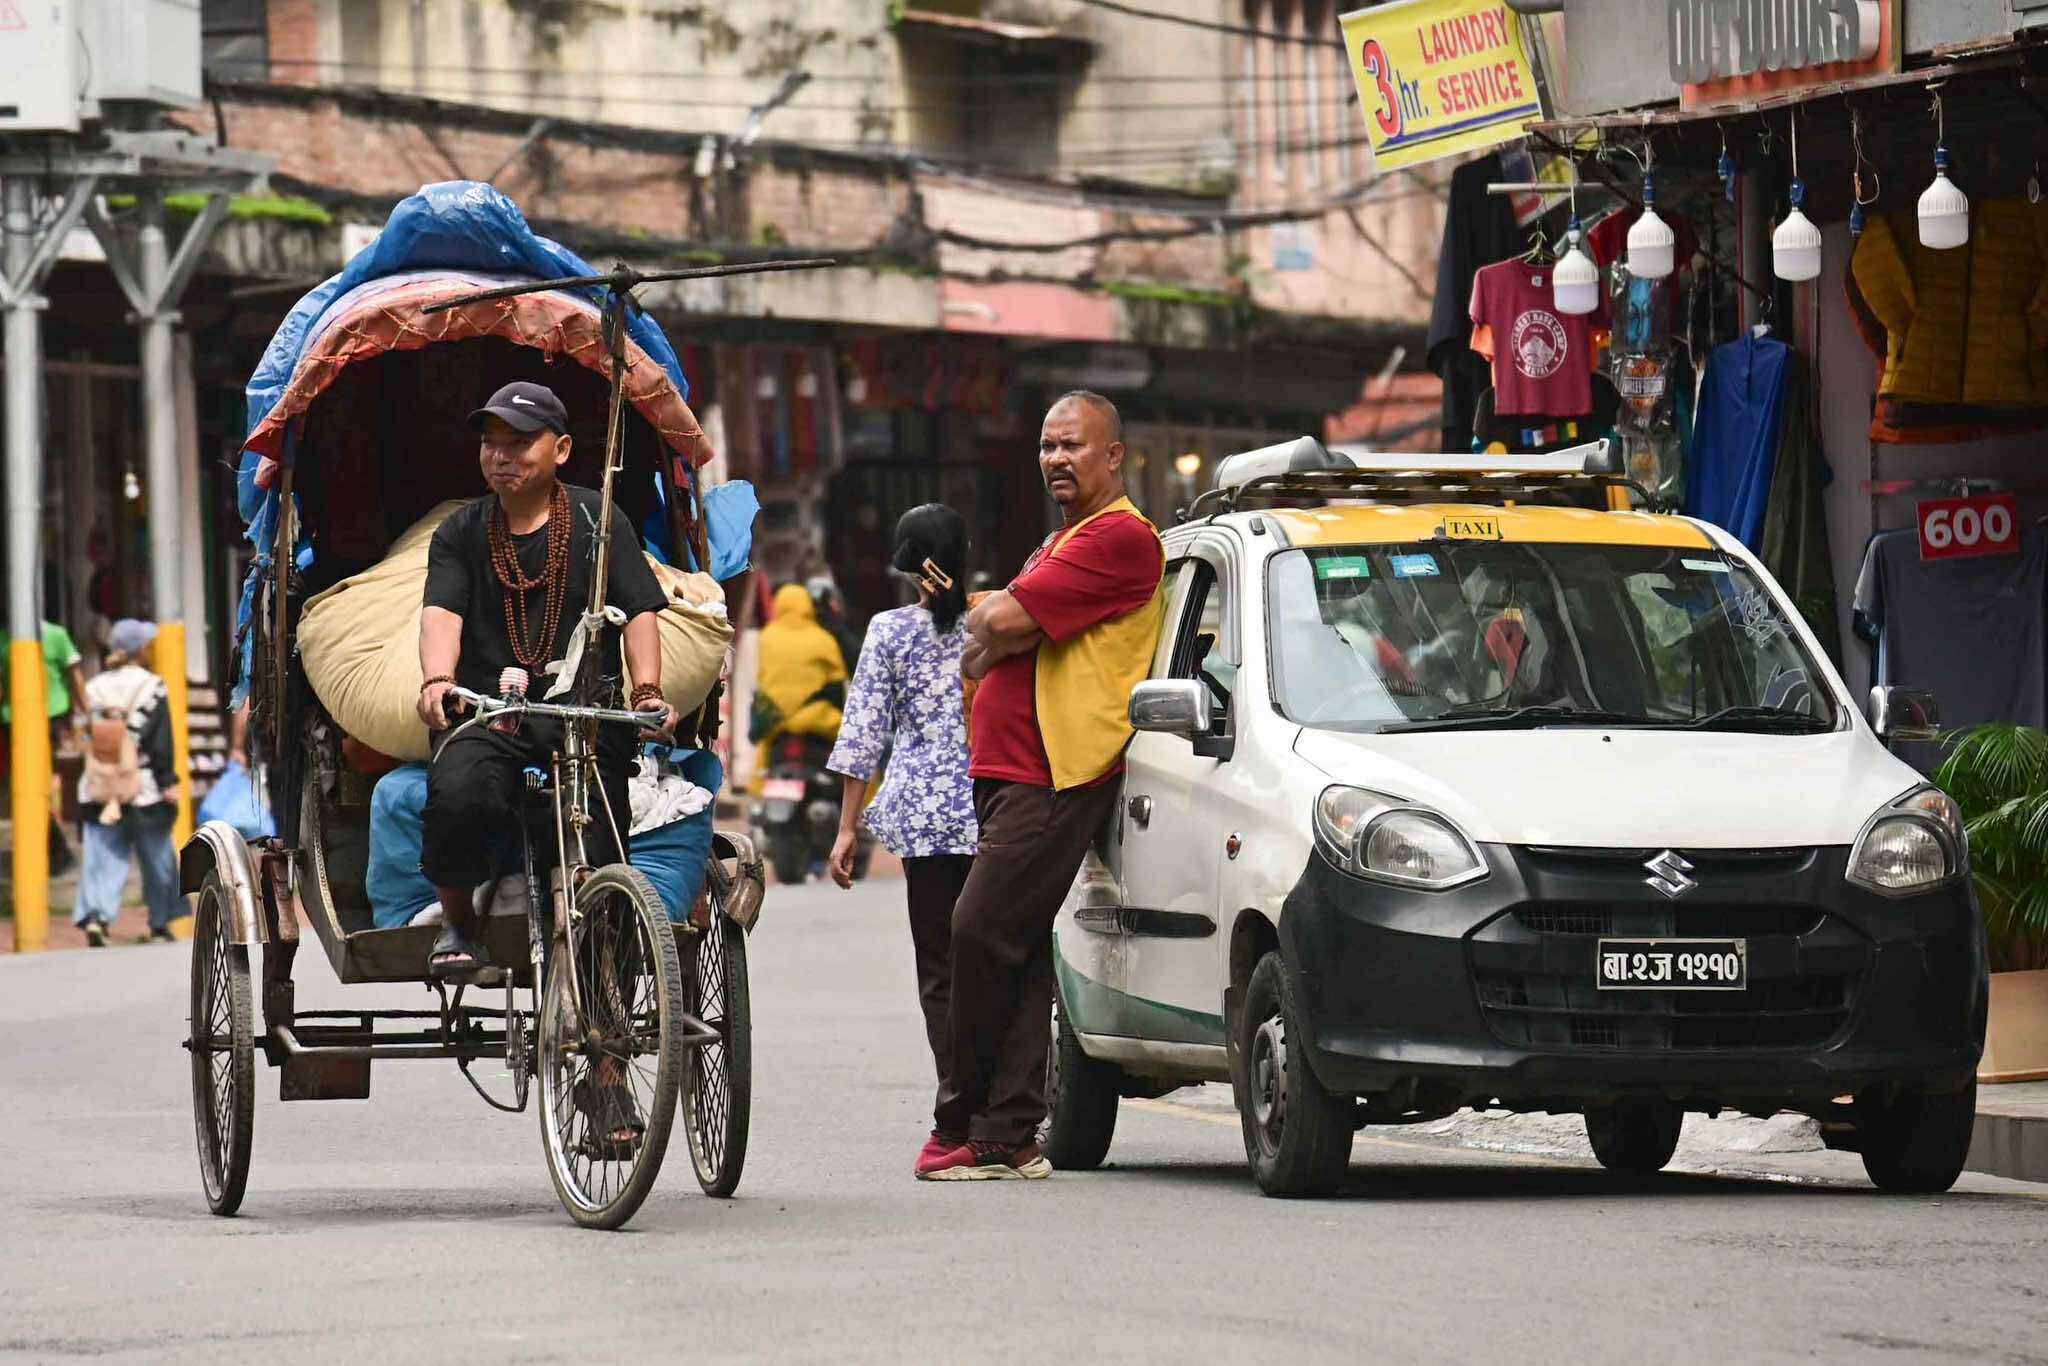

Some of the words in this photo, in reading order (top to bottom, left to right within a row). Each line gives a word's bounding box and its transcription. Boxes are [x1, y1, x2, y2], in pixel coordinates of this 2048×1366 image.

[1418, 6, 1508, 65] LAUNDRY
[1363, 39, 1402, 137] 3
[1396, 69, 1430, 121] hr.
[1437, 60, 1523, 116] SERVICE
[1450, 521, 1492, 535] TAXI
[1925, 505, 2012, 549] 600
[1677, 953, 1739, 981] १२१०
